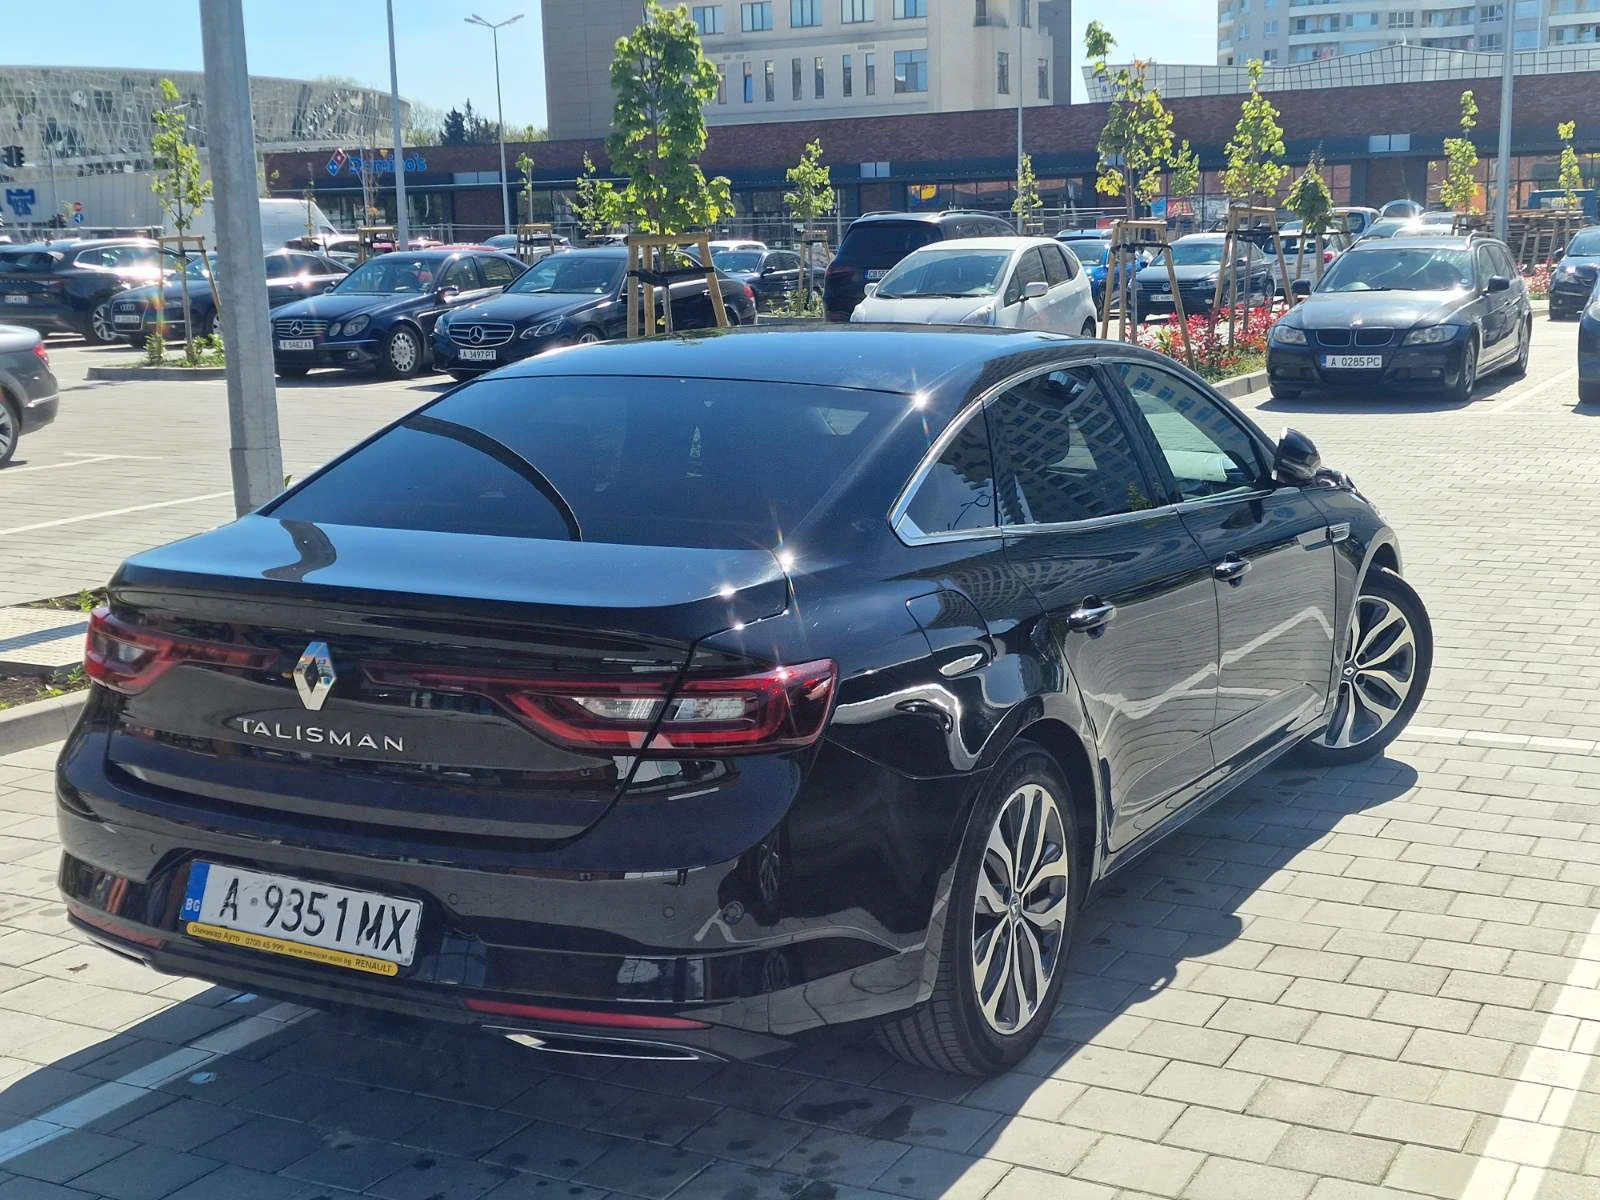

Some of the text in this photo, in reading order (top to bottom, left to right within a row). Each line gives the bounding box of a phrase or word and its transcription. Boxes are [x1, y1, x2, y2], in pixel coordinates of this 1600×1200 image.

[349, 152, 428, 175] Domio's
[1330, 356, 1380, 367] A 0285 PC
[236, 717, 404, 752] TALISMAN
[185, 898, 200, 912] BG
[219, 877, 411, 955] A 9351 MX
[355, 958, 393, 974] RENAULT
